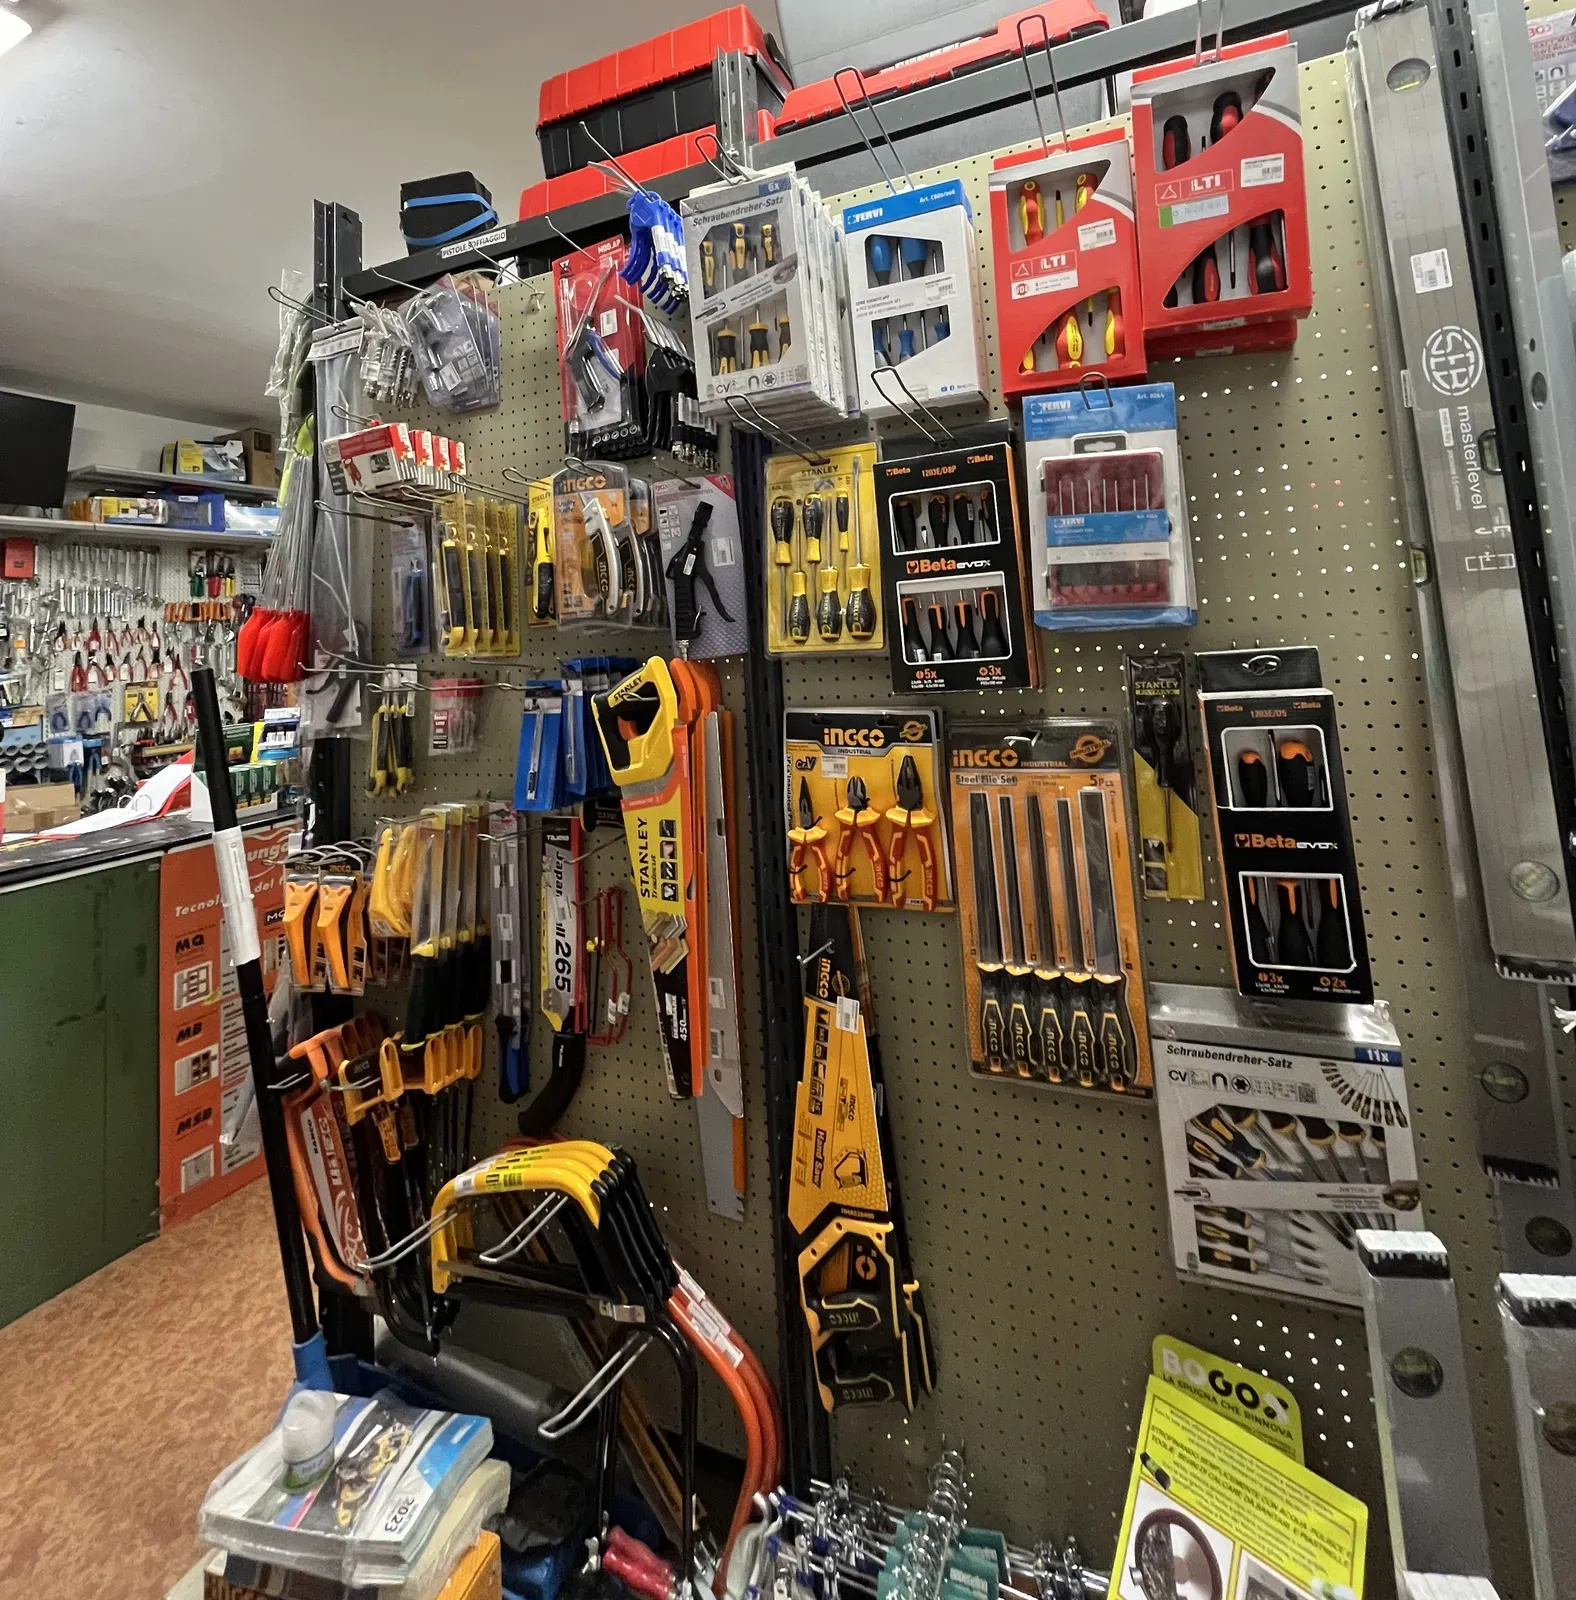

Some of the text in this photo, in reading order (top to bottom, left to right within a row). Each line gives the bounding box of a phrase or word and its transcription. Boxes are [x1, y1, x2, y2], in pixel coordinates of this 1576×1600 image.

[768, 182, 780, 193] 6x
[692, 196, 784, 227] Schraubendreher-Satz
[855, 207, 883, 223] FERVI
[442, 243, 466, 258] PISTOLE
[715, 381, 731, 394] CV
[1042, 399, 1071, 414] FERVI
[974, 454, 994, 463] Beta
[1457, 405, 1487, 510] masterlevel
[801, 465, 839, 477] STANLEY
[893, 467, 911, 476] Beta
[920, 557, 956, 572] Beta
[924, 668, 937, 679] 5x
[988, 665, 1002, 676] 3x
[613, 676, 643, 702] STANLEY
[1135, 681, 1179, 690] STANLEY
[1301, 701, 1321, 709] Beta
[1021, 760, 1068, 768] INDUSTRIAL
[956, 774, 978, 785] Steel
[980, 774, 997, 785] File
[1251, 833, 1296, 849] Beta
[637, 816, 651, 899] STANLEY
[554, 850, 566, 898] Japan
[254, 878, 275, 894] del
[554, 940, 572, 993] 265
[1269, 972, 1284, 983] 3x
[1332, 976, 1347, 988] 2x
[1166, 1044, 1294, 1070] Schraubendreher-Satz
[1366, 1049, 1390, 1064] 11x
[1168, 1069, 1188, 1083] CV
[812, 1129, 825, 1189] Hand Saw
[1162, 1373, 1294, 1441] LA SPUGNA CHE RINNOVA
[384, 1496, 415, 1533] 2023
